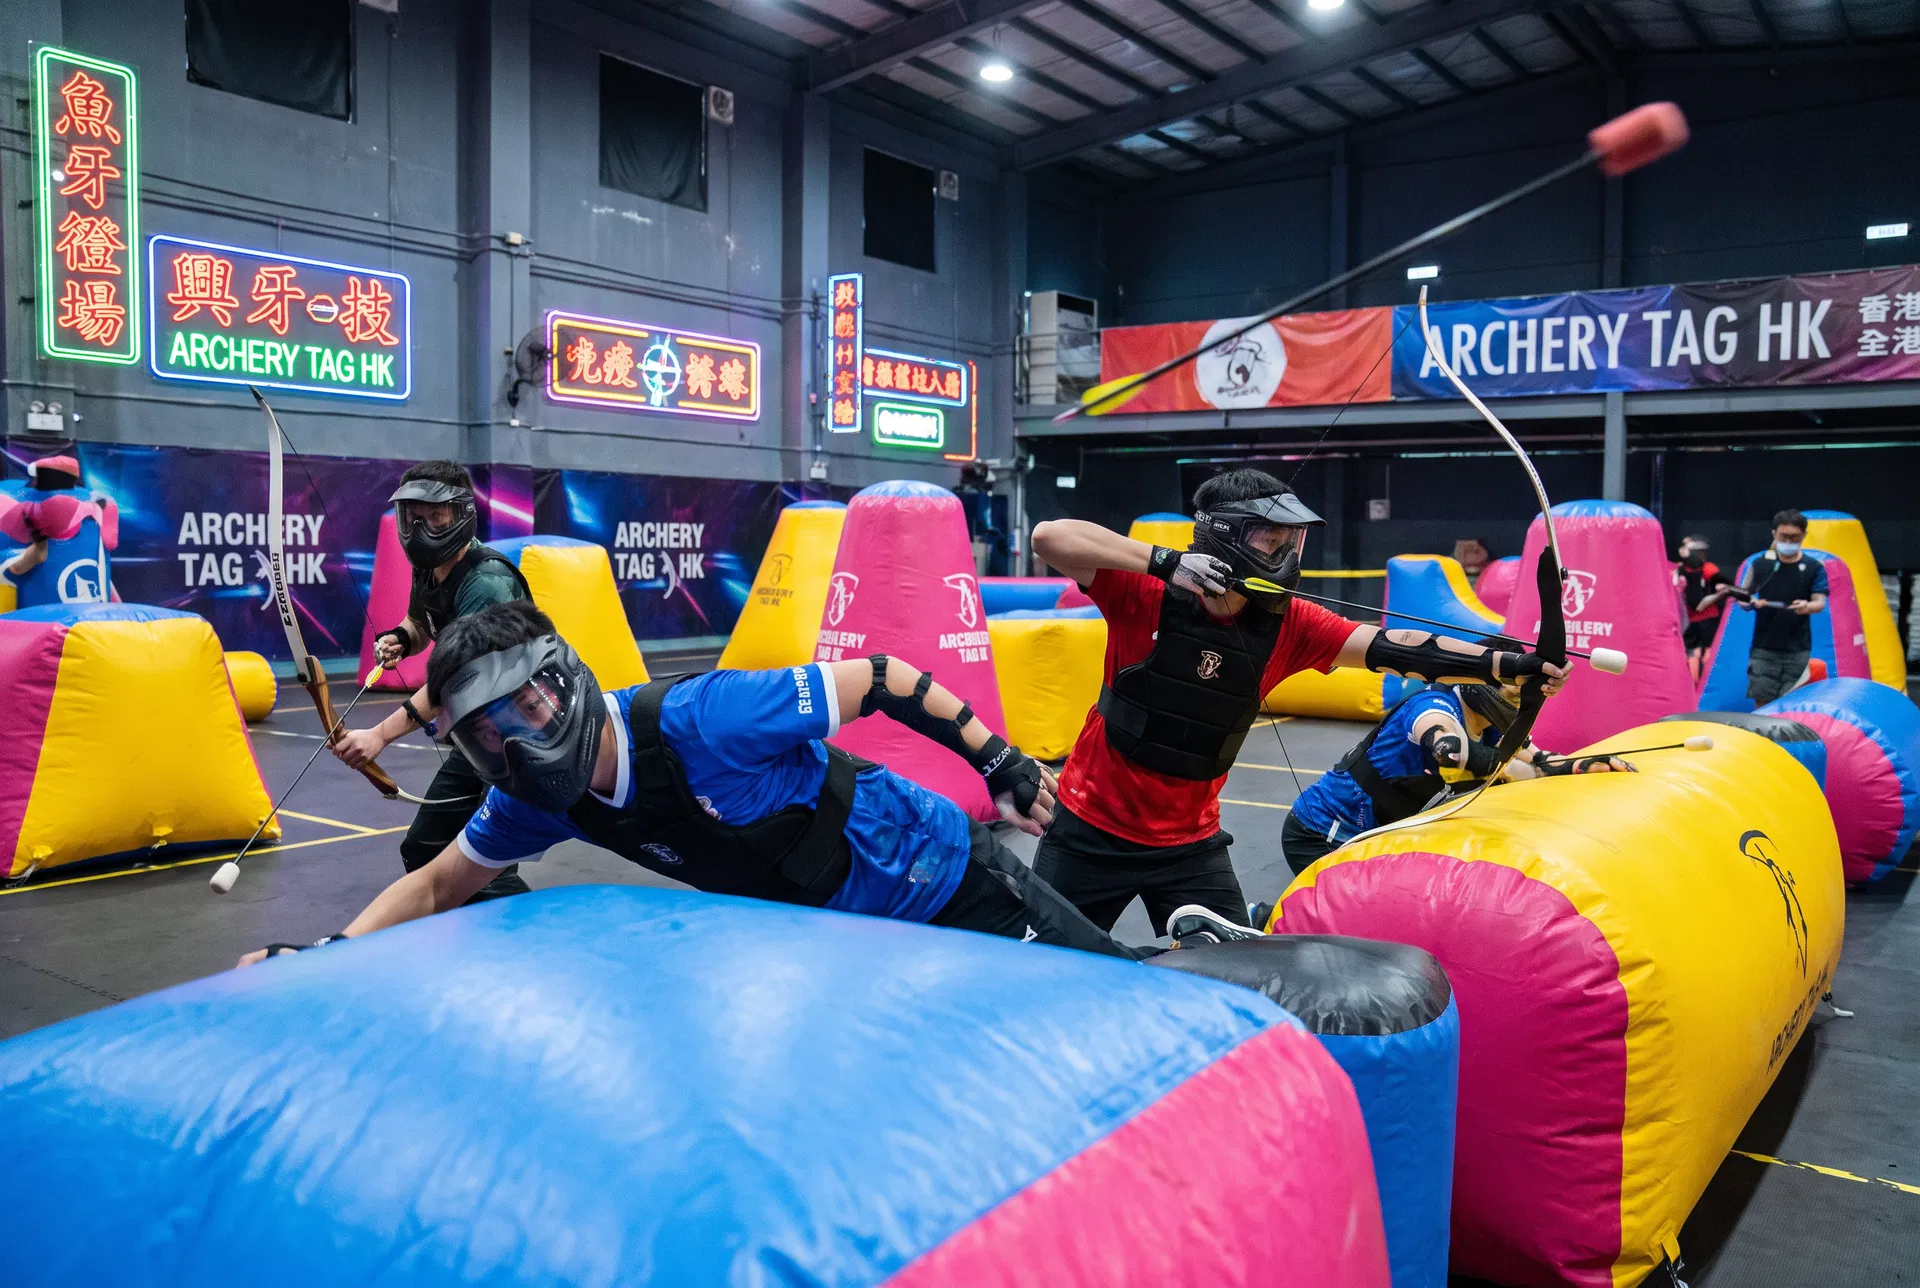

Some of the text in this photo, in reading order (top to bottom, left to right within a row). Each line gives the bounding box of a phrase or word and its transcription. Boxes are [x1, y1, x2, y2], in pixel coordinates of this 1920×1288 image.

[1420, 299, 1832, 378] ARCHERY TAG HK
[169, 331, 394, 387] ARCHERY TAG HK
[177, 512, 326, 547] ARCHRY
[614, 521, 705, 548] ARCHERY
[177, 552, 328, 587] TAG HK
[614, 552, 705, 580] TAG HK
